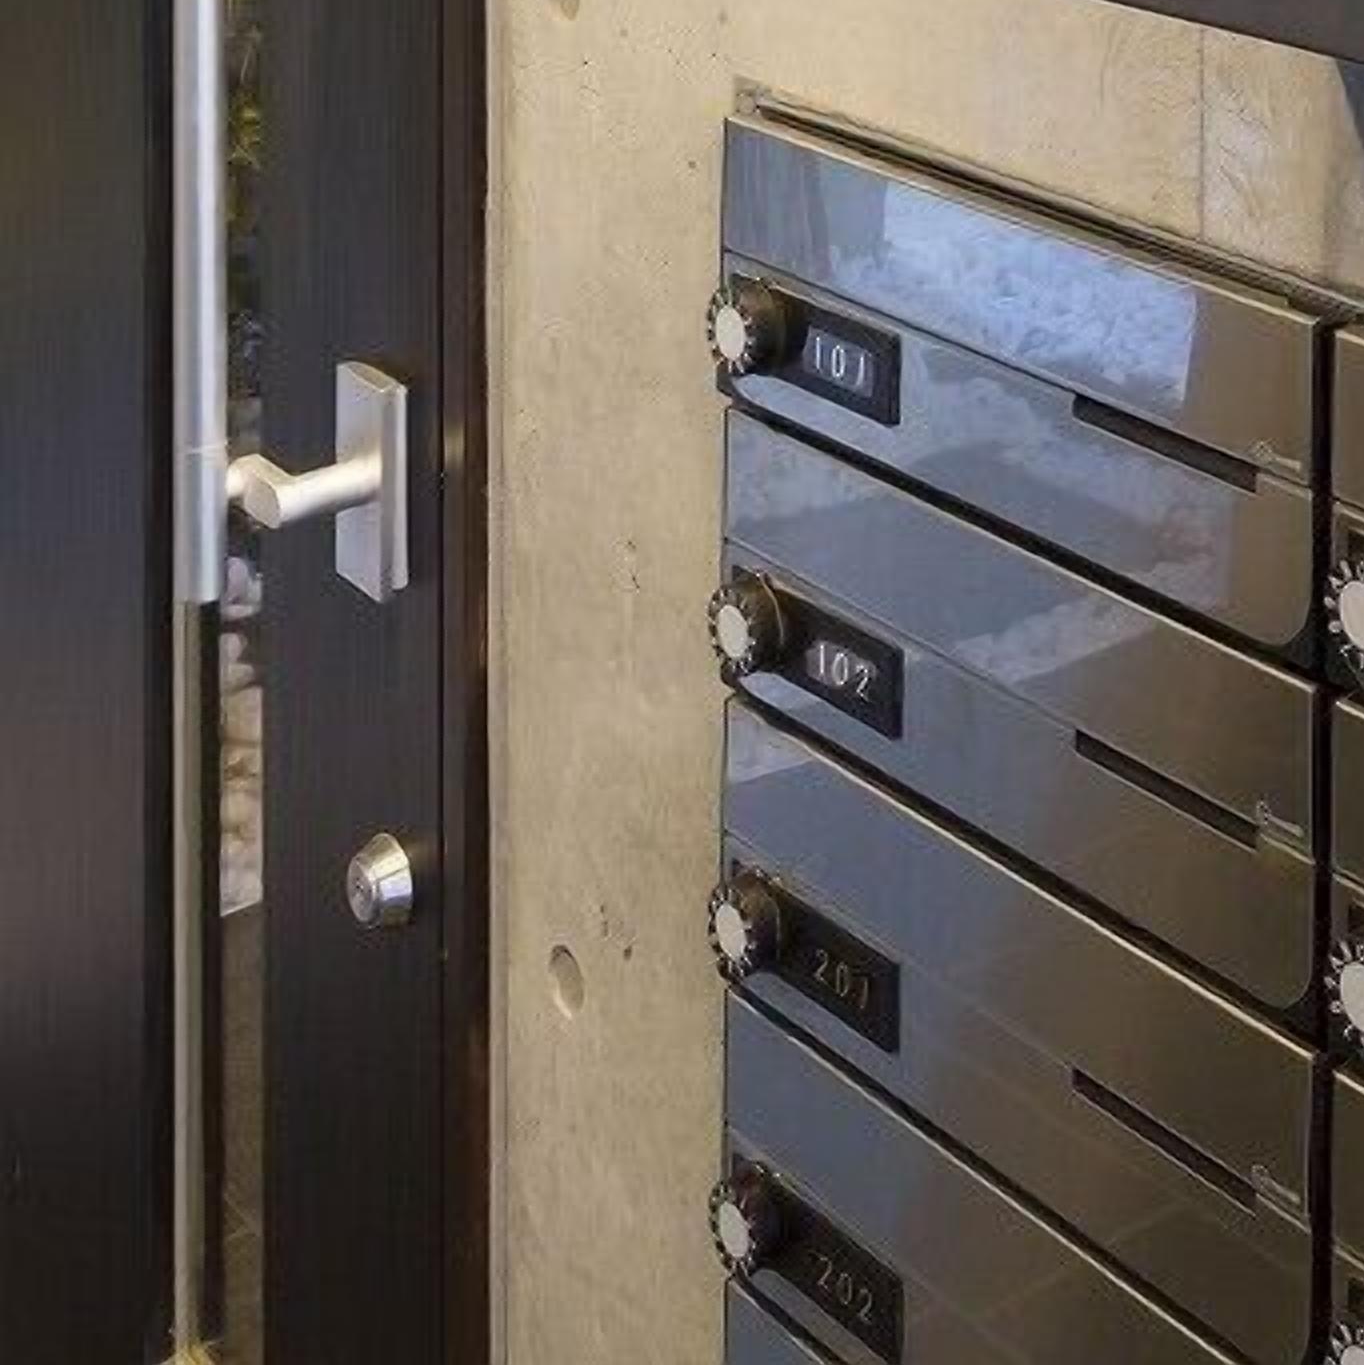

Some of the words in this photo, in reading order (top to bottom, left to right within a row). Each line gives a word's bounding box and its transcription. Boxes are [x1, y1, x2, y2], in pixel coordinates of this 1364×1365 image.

[814, 335, 866, 388] 101
[818, 643, 870, 703] 102
[815, 1255, 874, 1324] 202
